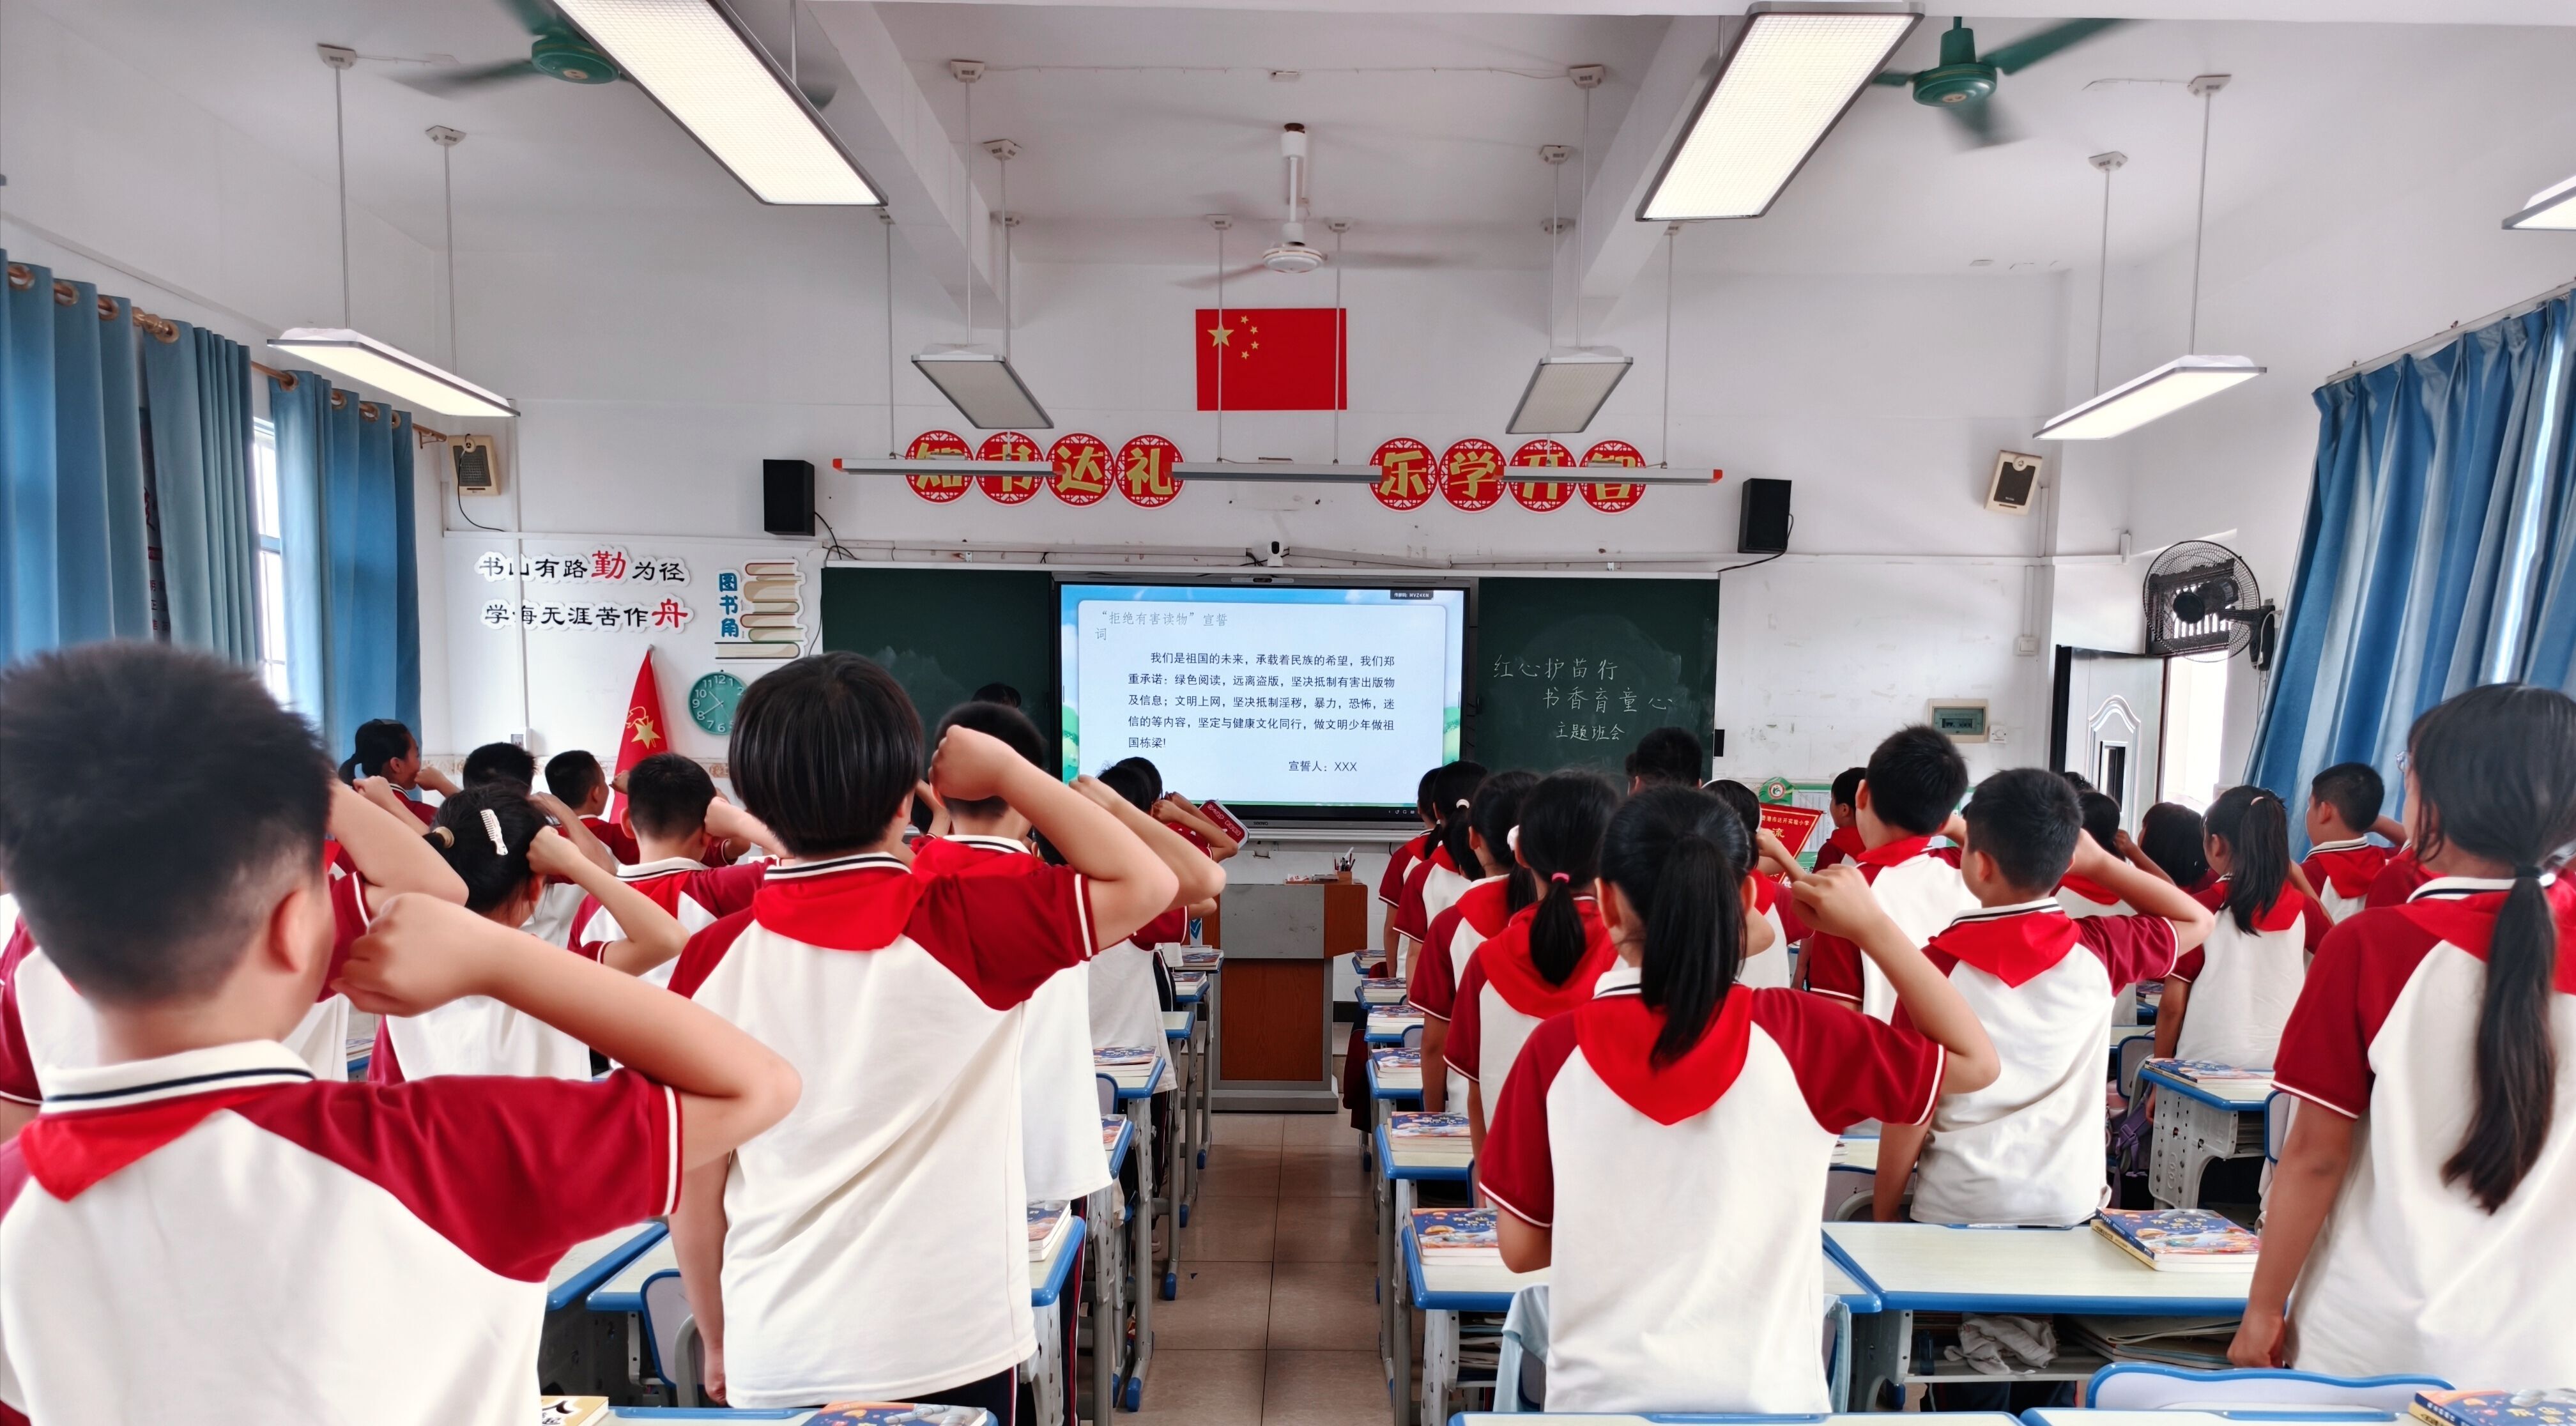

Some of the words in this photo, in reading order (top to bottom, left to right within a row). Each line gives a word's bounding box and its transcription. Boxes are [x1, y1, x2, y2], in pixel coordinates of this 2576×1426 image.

[480, 550, 686, 582] 书山有路勤为径
[719, 572, 739, 638] 图书角
[485, 598, 688, 629] 学海无涯苦作舟
[1095, 627, 1107, 641] 词
[1151, 652, 1395, 667] 我们是祖国的未来，承载着民族的希望，我们郑
[1494, 654, 1618, 681] 红心护苗行
[703, 680, 712, 688] 11
[714, 675, 726, 684] 12
[729, 678, 733, 686] 1
[1128, 673, 1395, 689] 重承诺：绿色阅读，远离盗版，坚决抵制有害出版物
[695, 689, 707, 698] 10
[737, 687, 744, 696] 2
[693, 699, 700, 708] 9
[1128, 694, 1395, 710] 及信息；文明上网，坚决抵制淫秽，暴力，恐怖，迷
[1543, 686, 1673, 713] 书香育童心
[697, 710, 705, 720] 8
[707, 720, 714, 729] 7
[717, 723, 725, 732] 6
[1128, 716, 1395, 731] 信的等内容，坚定与健康文化同行，做文明少年做祖
[1556, 721, 1625, 741] 主题班会
